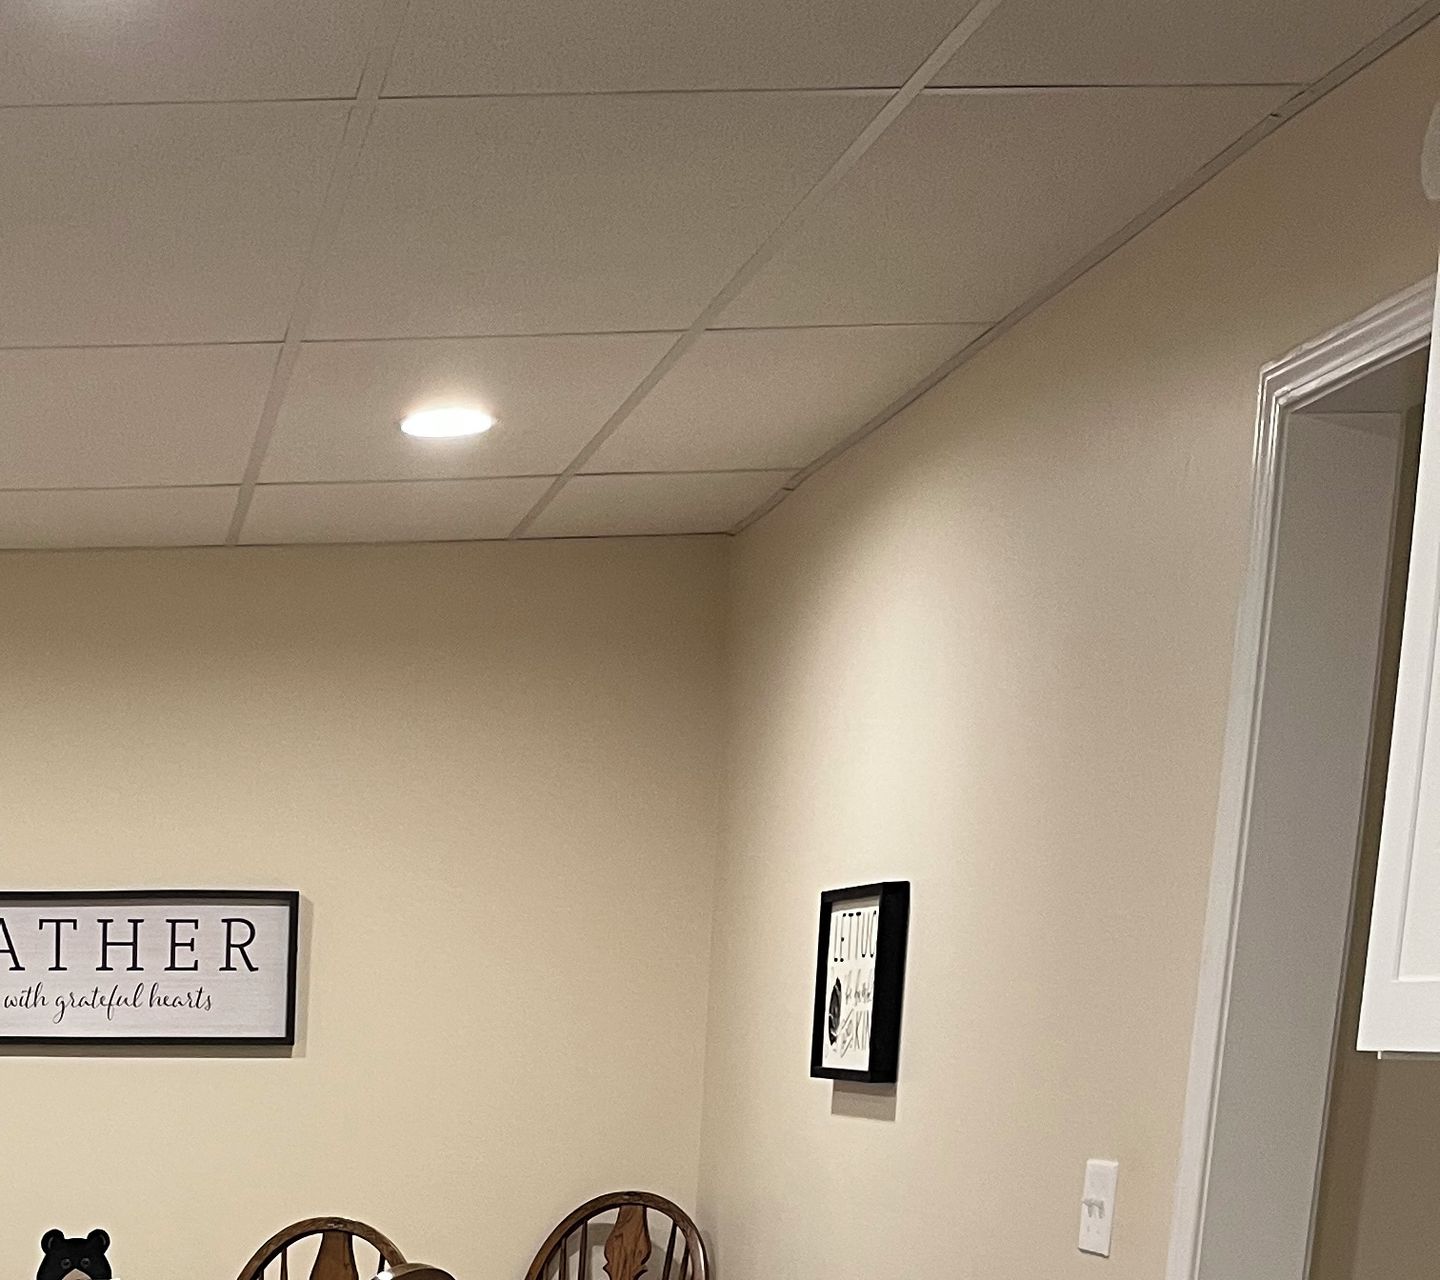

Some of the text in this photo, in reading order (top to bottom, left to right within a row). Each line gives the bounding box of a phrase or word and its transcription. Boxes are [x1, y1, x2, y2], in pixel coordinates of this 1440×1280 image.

[3, 982, 48, 1009] with
[52, 981, 144, 1024] grateful
[147, 982, 213, 1012] hearts
